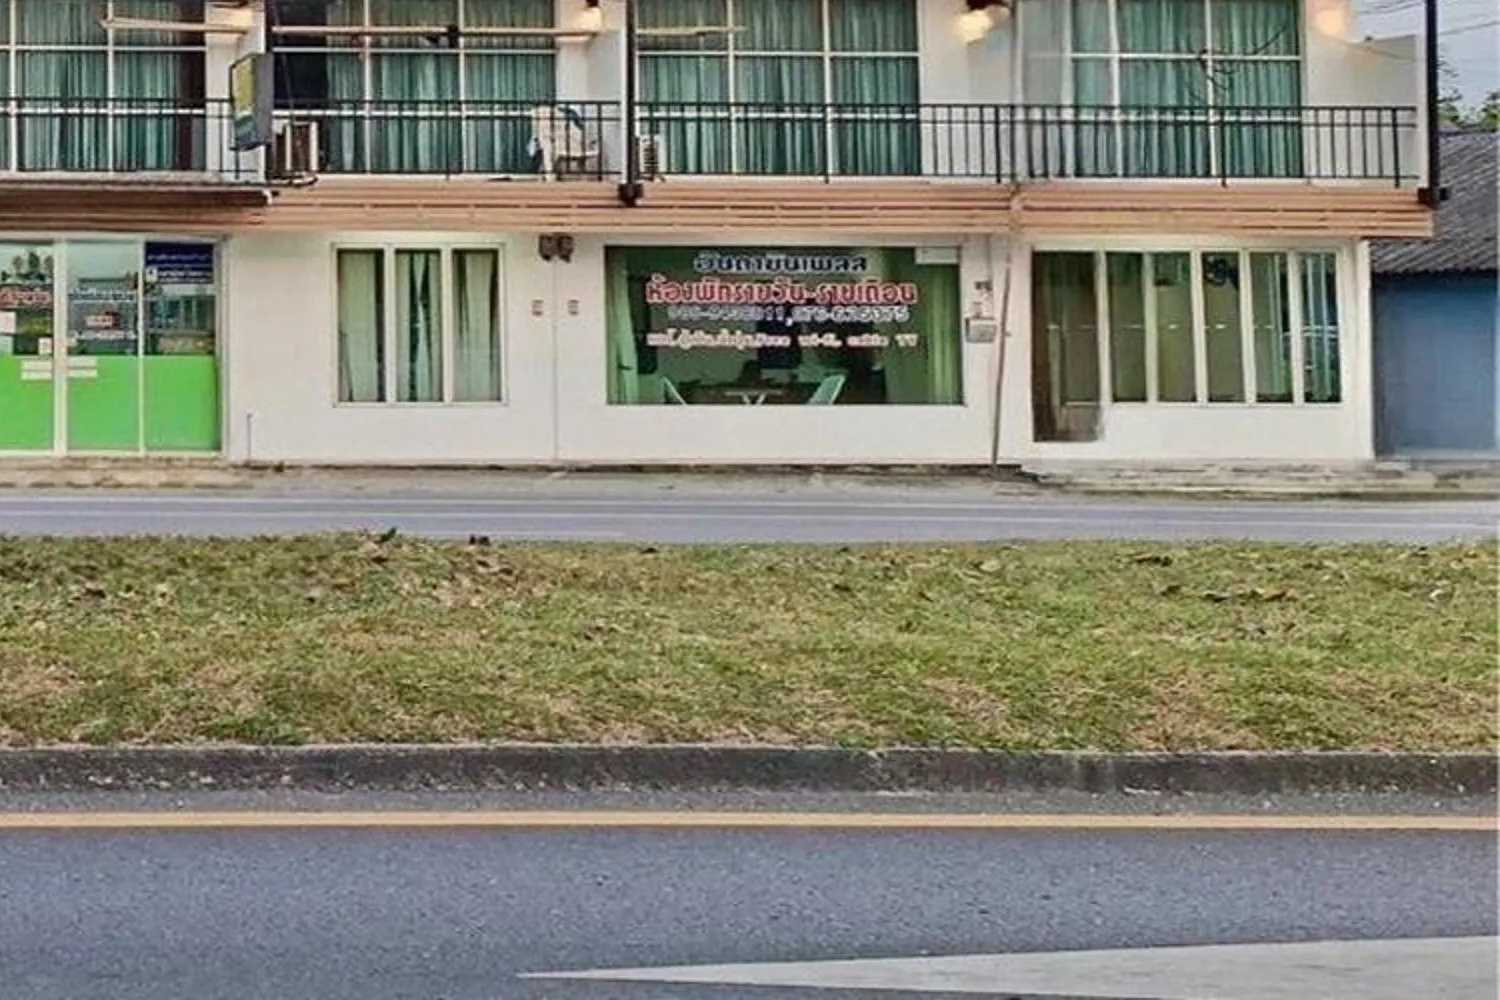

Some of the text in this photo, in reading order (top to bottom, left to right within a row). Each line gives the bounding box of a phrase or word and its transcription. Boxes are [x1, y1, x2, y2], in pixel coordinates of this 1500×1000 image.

[645, 273, 918, 304] ห้องพักรายวัน-รายเดือน
